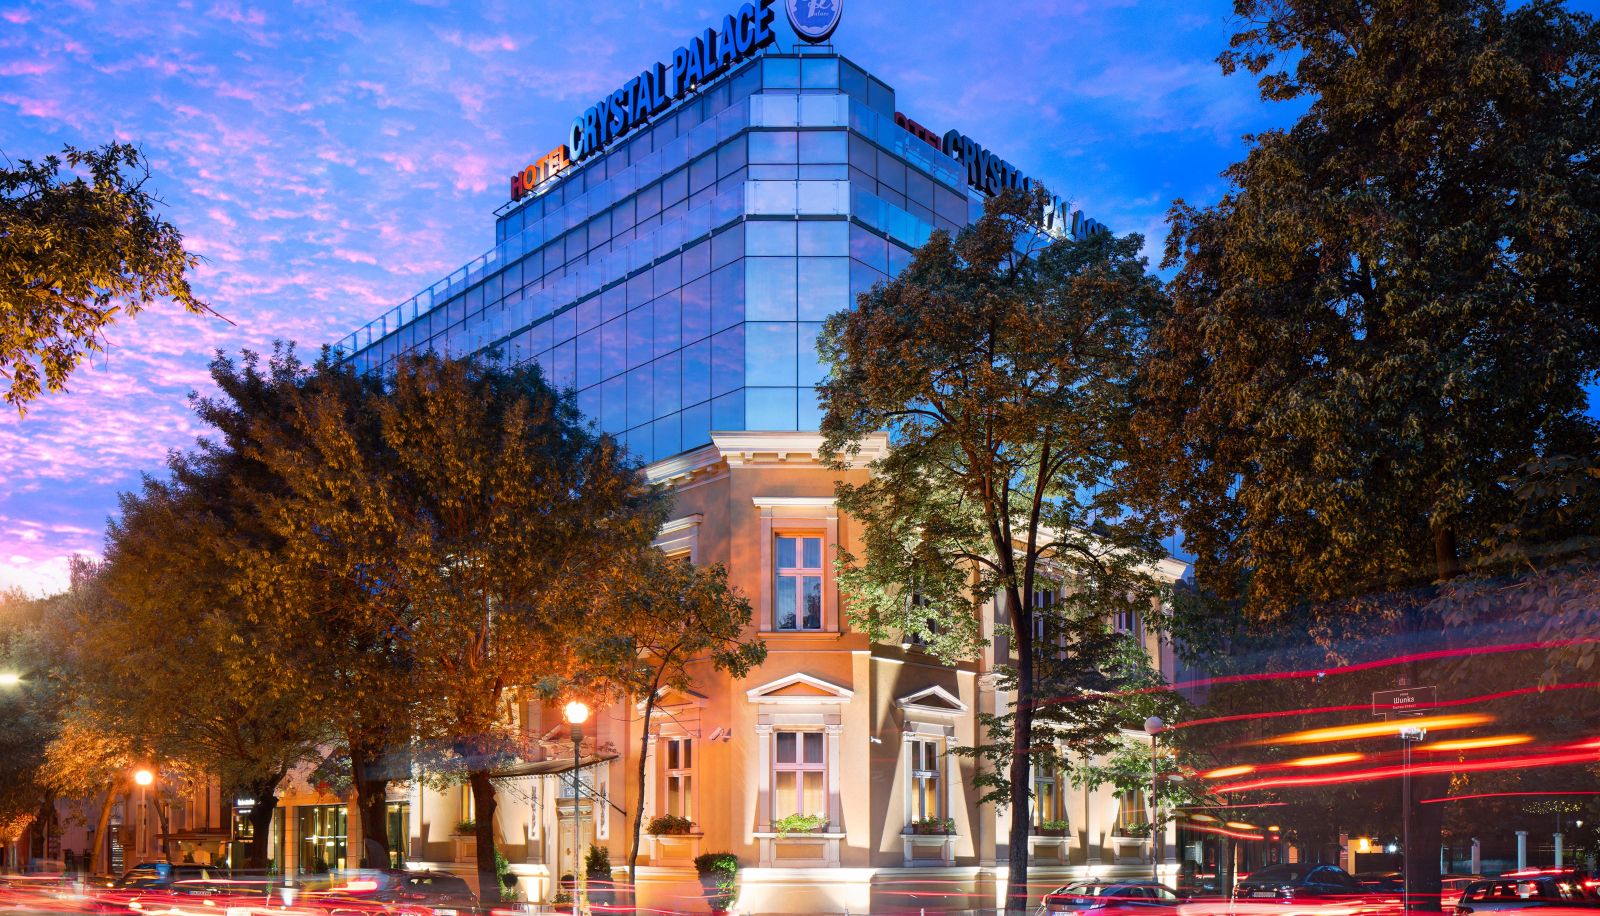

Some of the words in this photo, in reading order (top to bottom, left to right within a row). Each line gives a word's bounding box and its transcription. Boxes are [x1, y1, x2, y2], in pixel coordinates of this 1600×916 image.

[511, 144, 570, 201] HOTEL
[569, 62, 671, 161] CRYSTAL
[673, 0, 775, 99] PALACE
